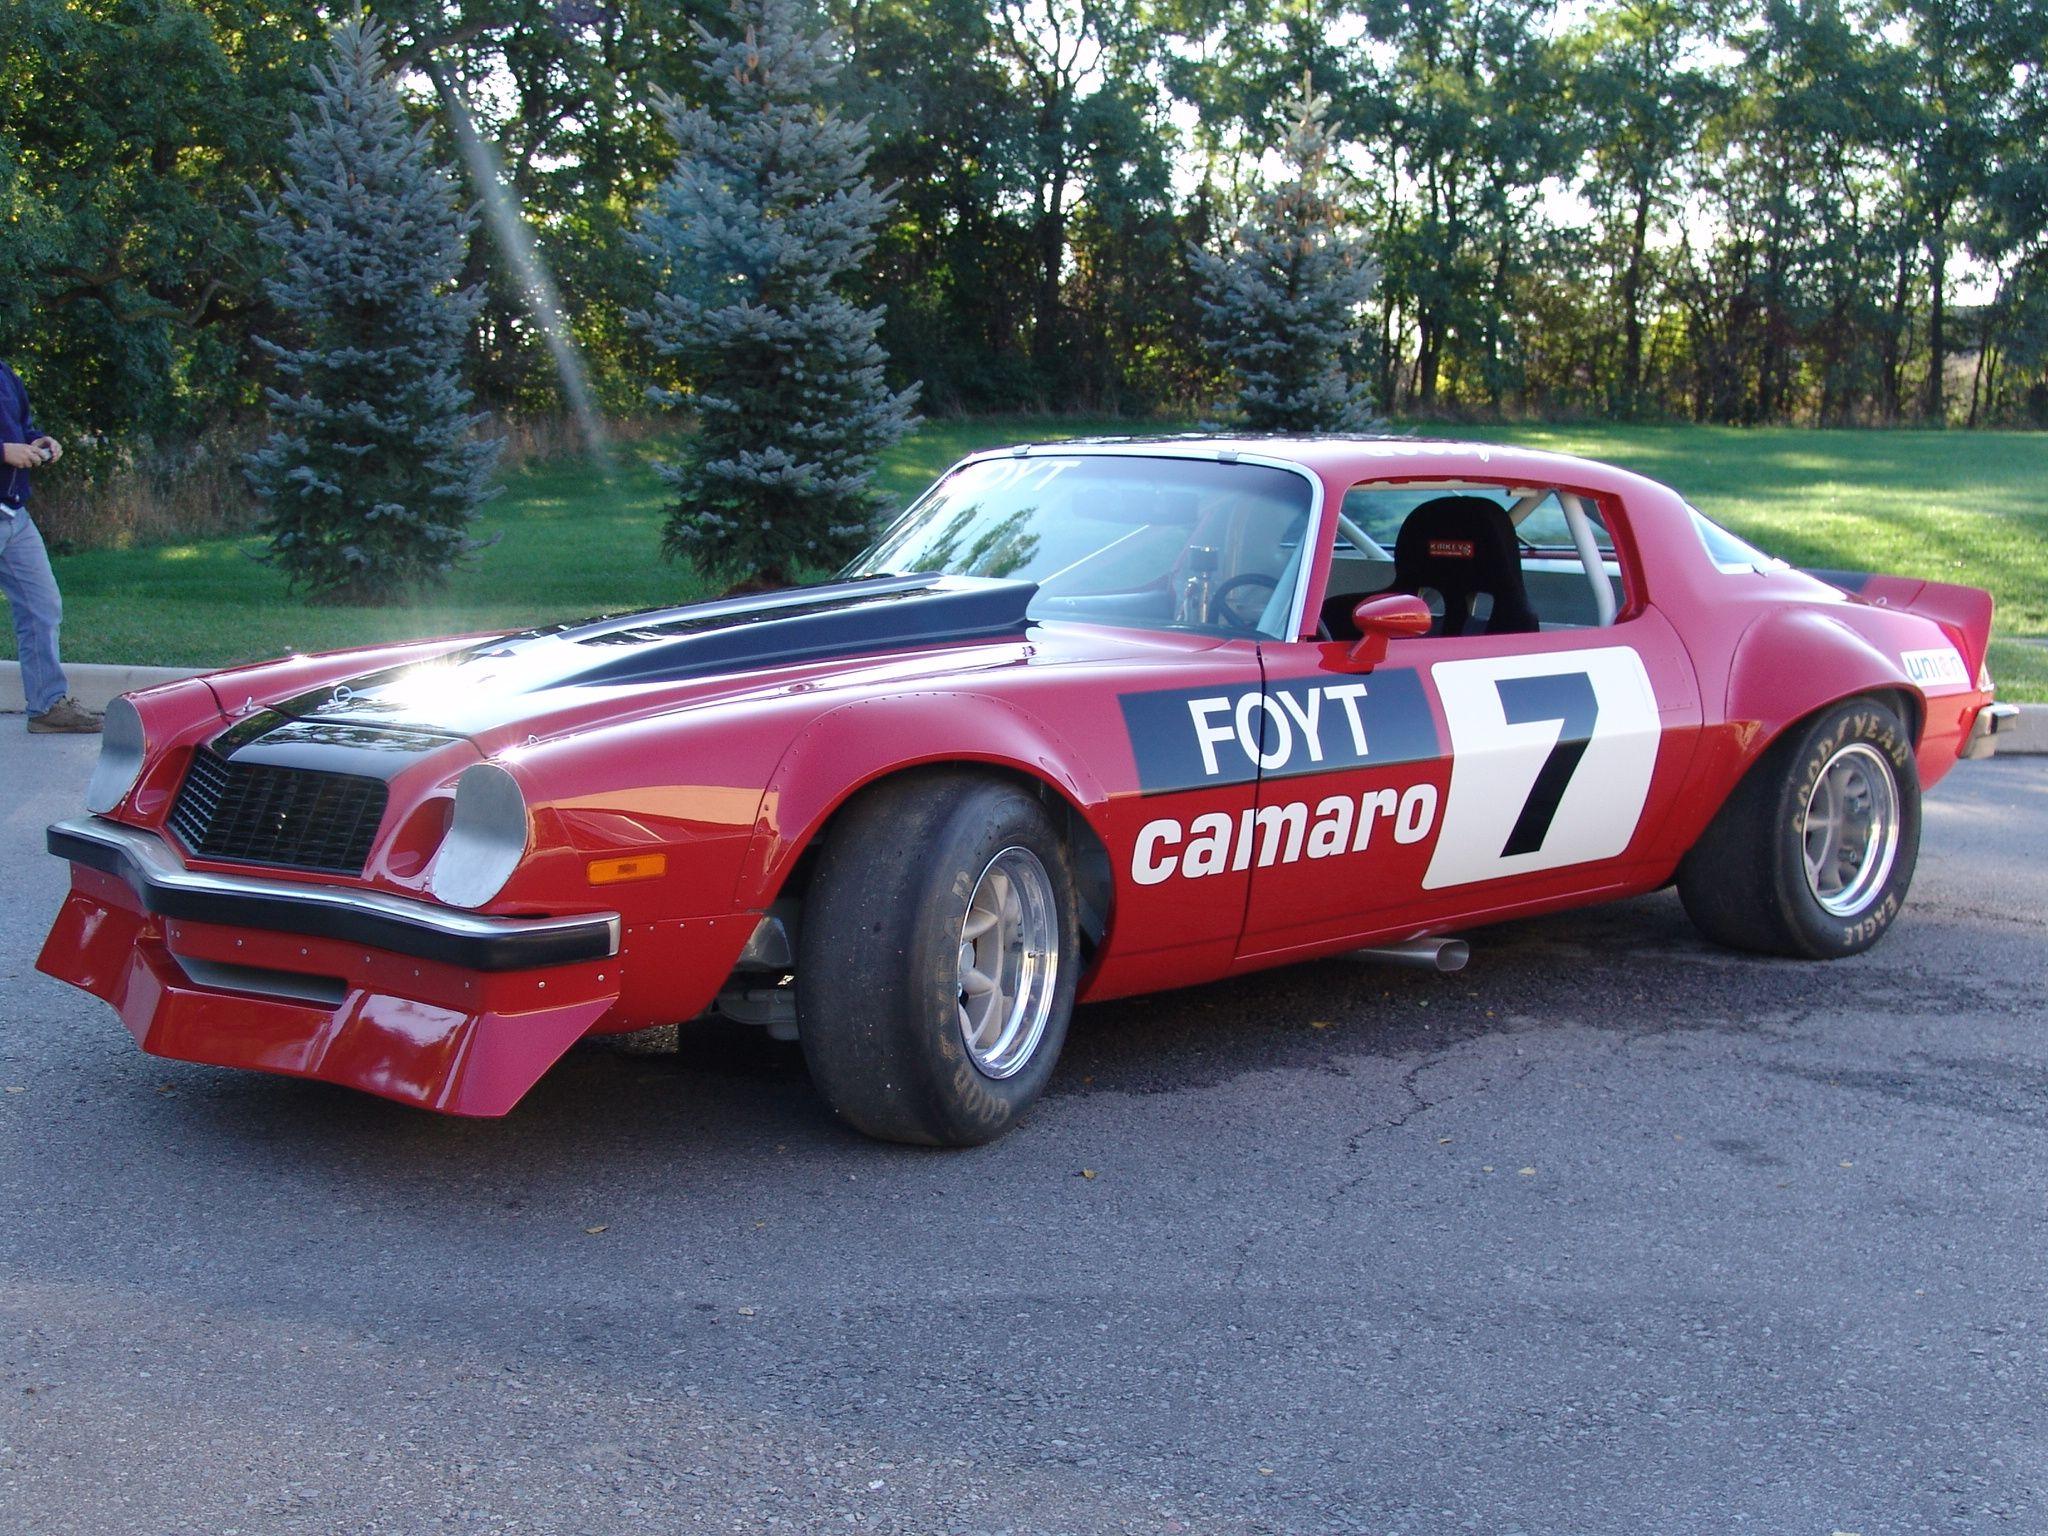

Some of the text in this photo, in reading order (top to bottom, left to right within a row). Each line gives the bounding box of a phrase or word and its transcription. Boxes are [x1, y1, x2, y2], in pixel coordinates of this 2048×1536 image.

[1187, 682, 1369, 775] FOYT
[1494, 671, 1599, 859] 7
[1131, 783, 1438, 885] camaro
[1843, 892, 1898, 946] EAGLE
